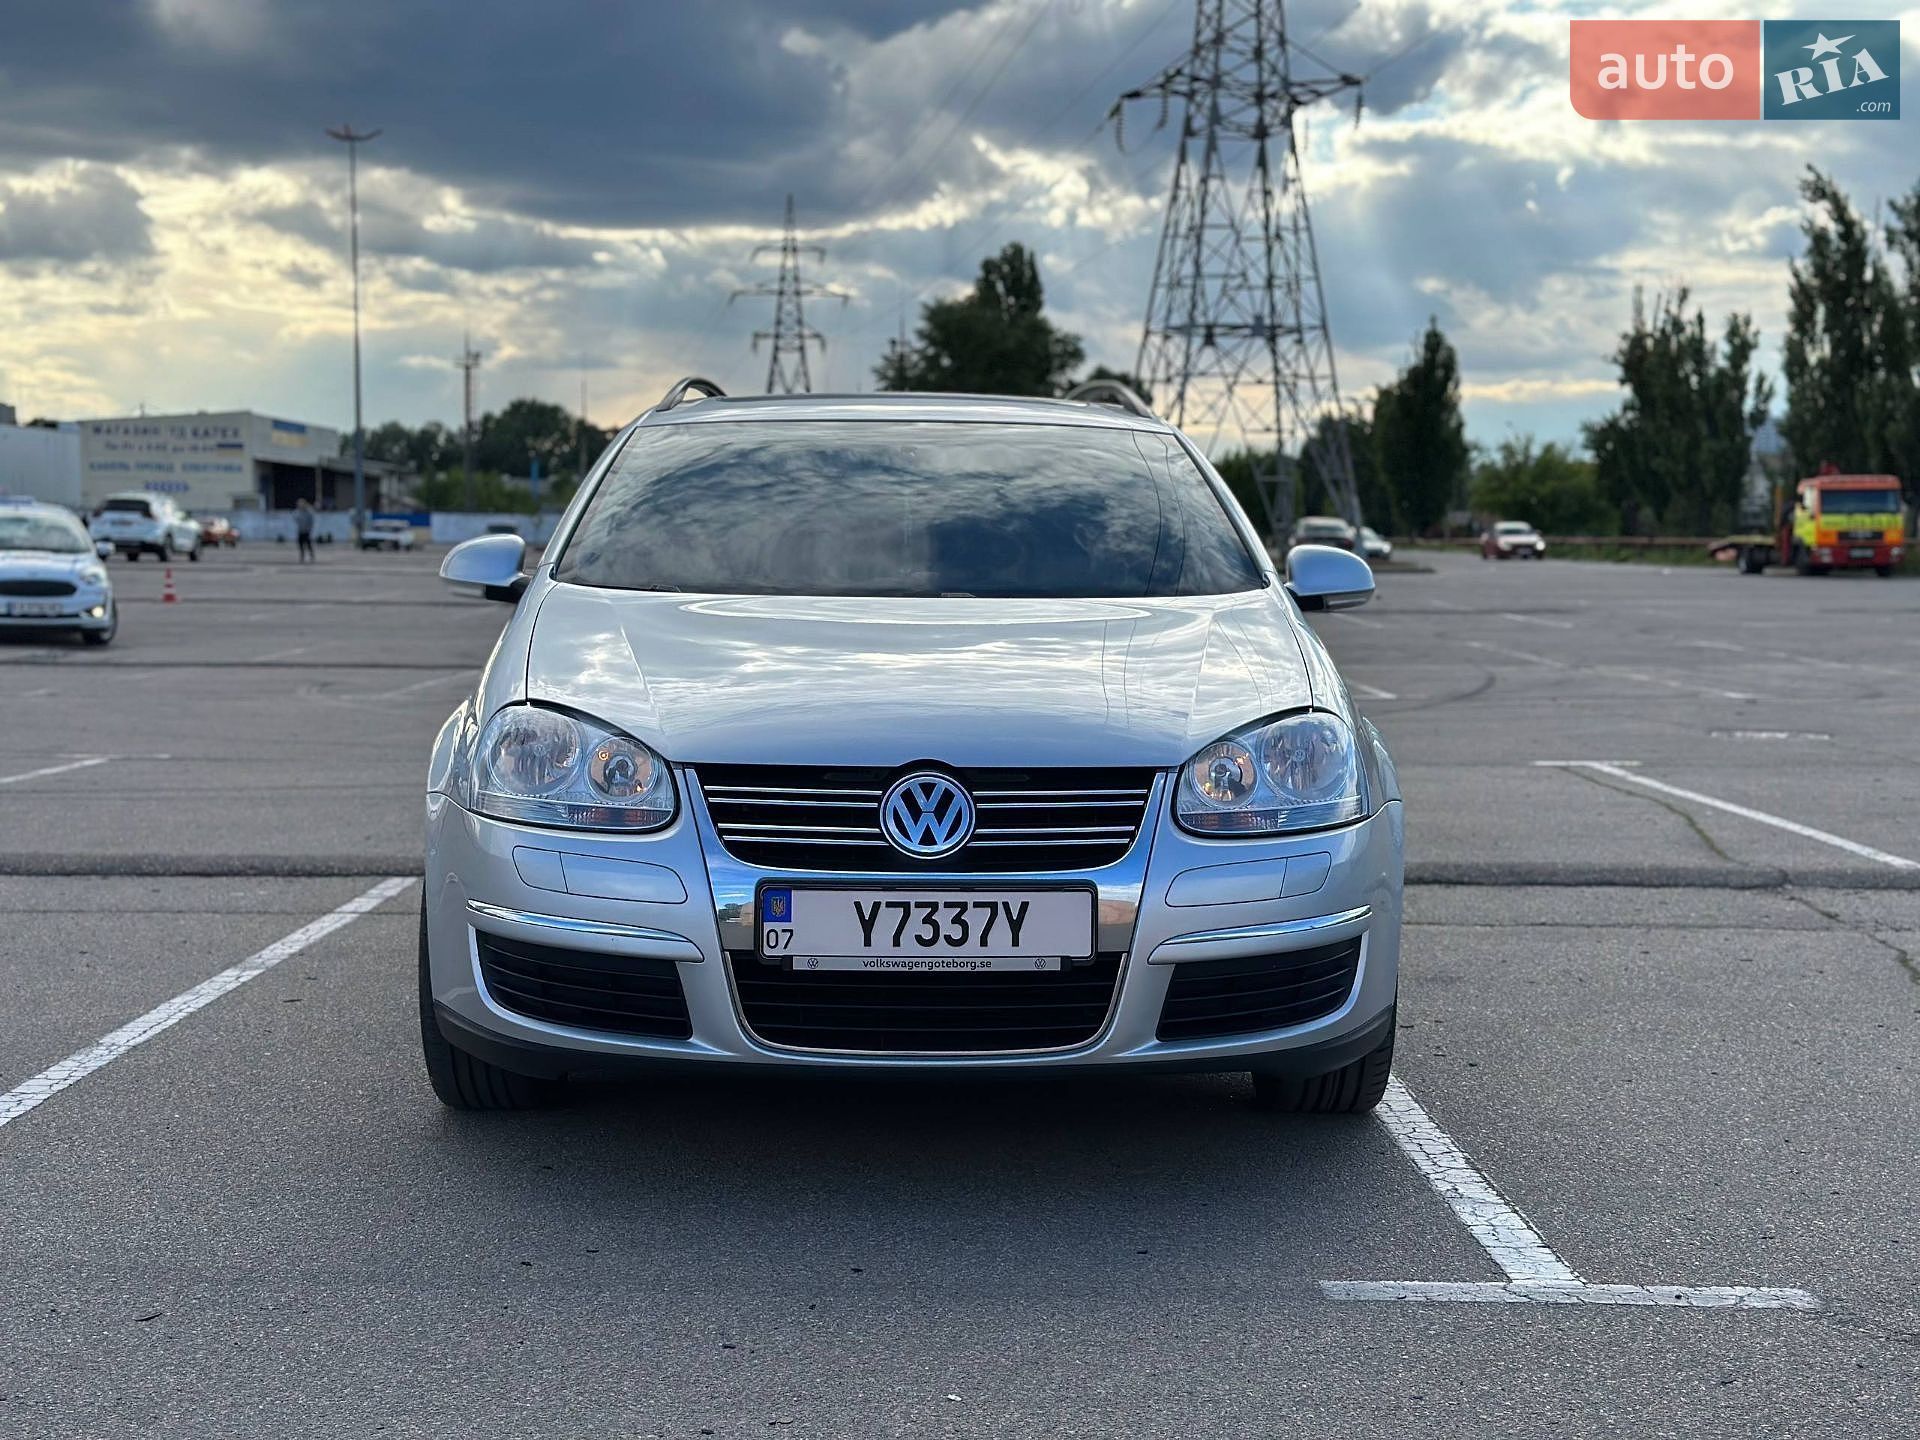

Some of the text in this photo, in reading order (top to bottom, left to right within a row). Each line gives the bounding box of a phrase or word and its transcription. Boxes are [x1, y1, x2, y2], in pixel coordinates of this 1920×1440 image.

[853, 900, 1030, 948] Y7337Y
[766, 928, 794, 950] 07
[862, 958, 992, 971] volkswagengoteborg.se
